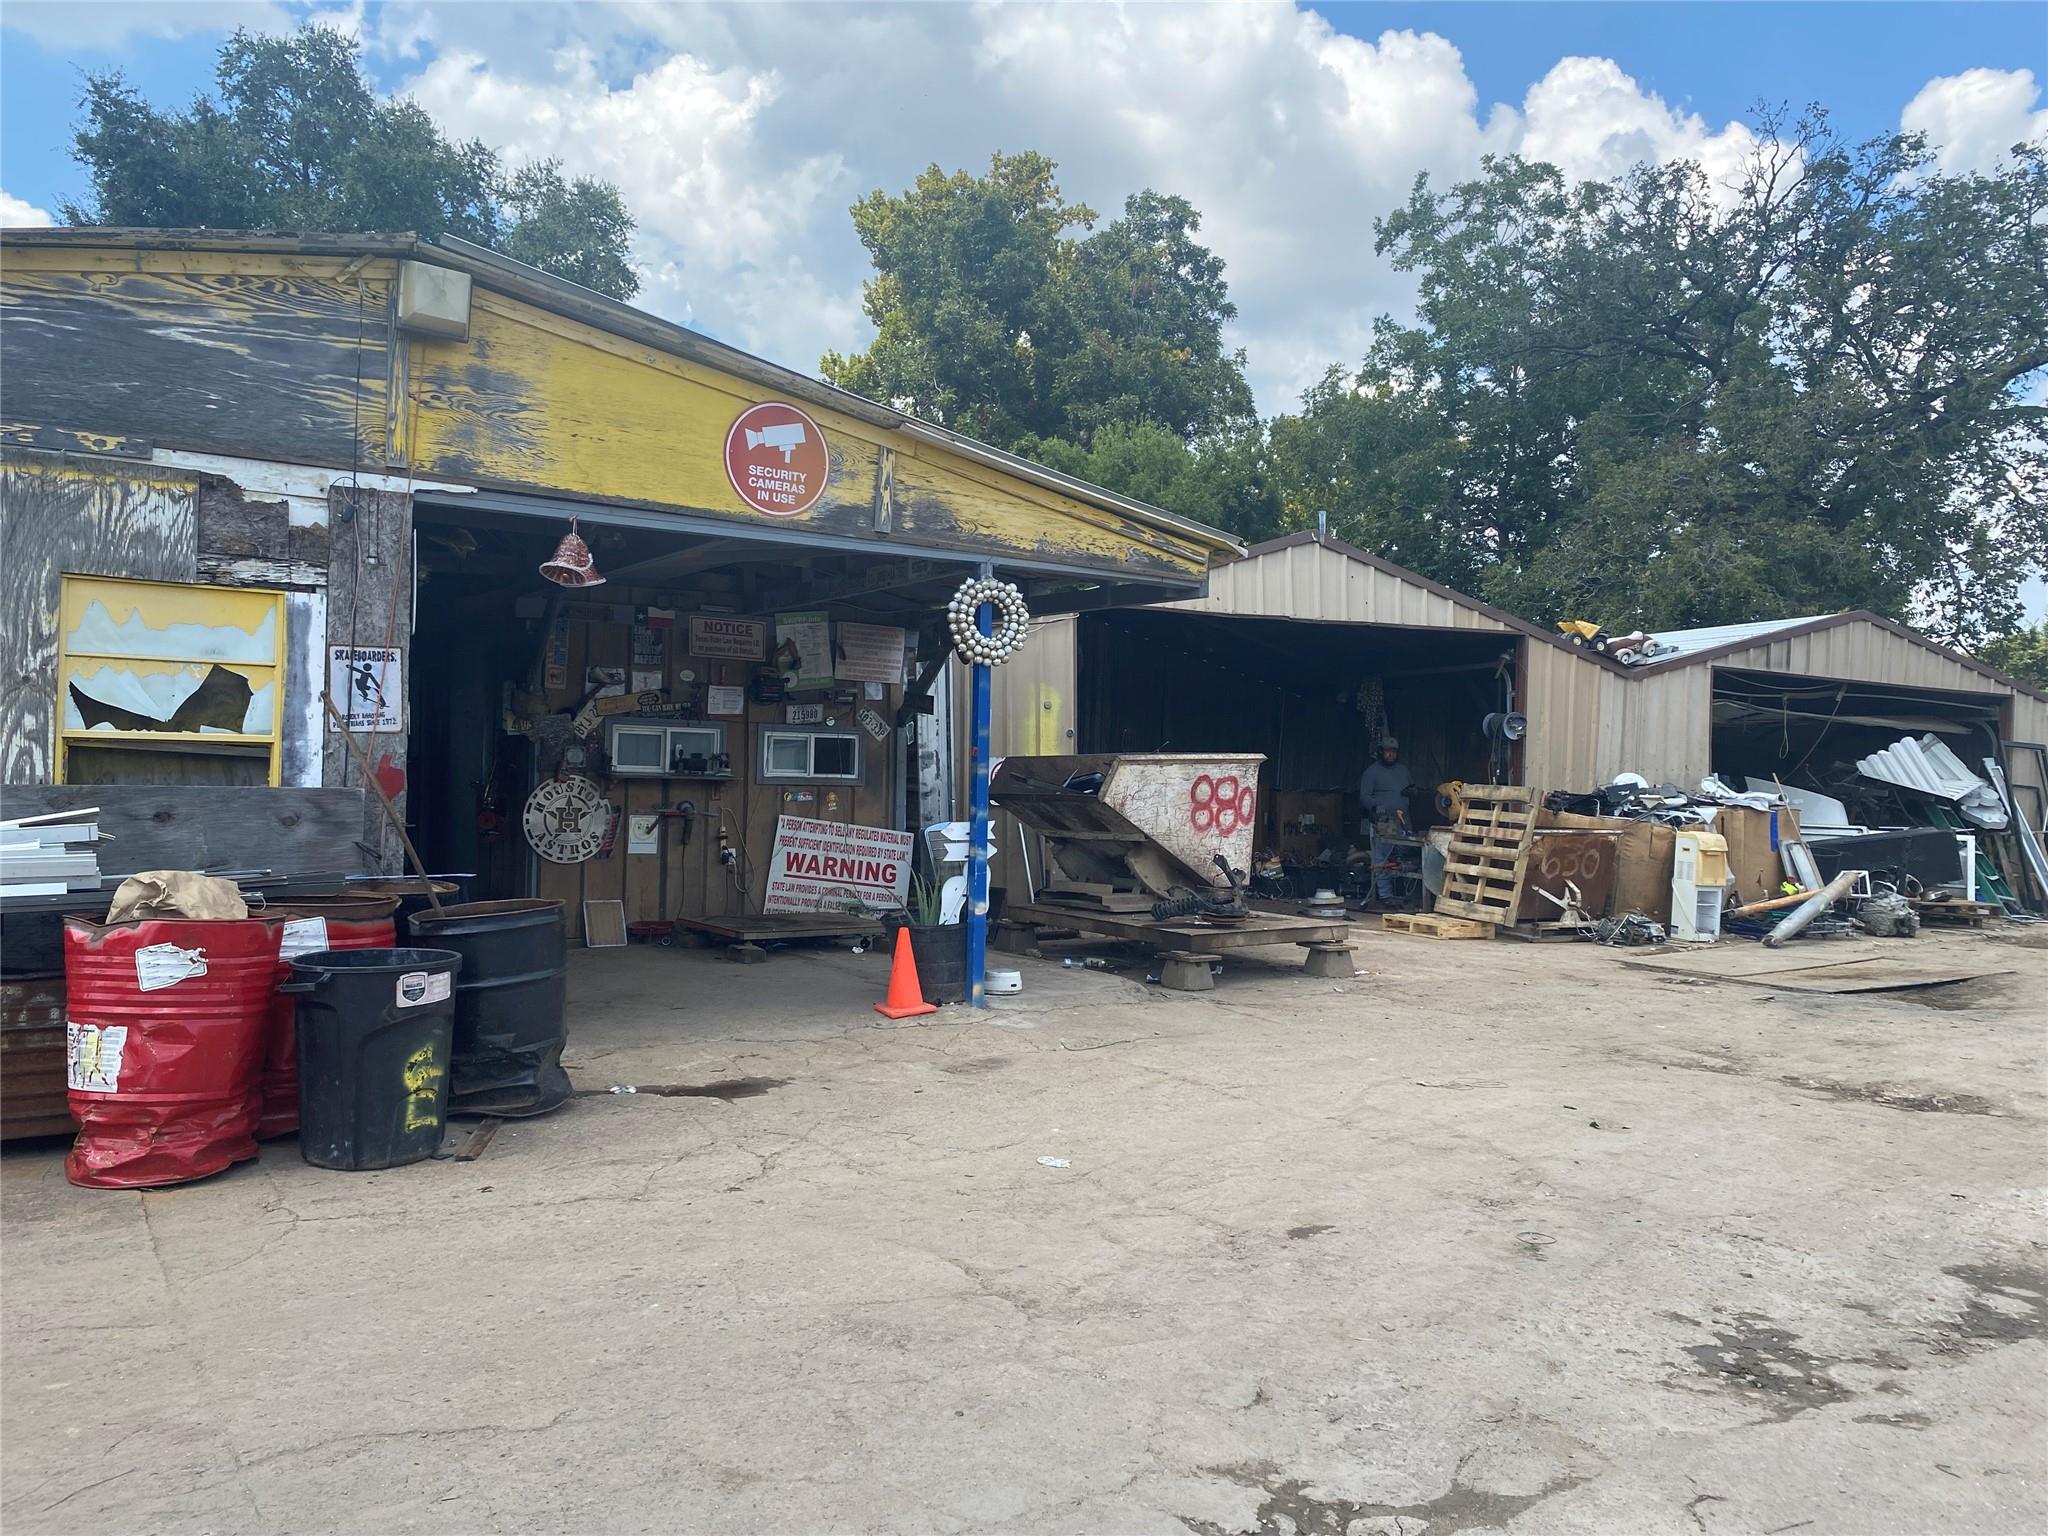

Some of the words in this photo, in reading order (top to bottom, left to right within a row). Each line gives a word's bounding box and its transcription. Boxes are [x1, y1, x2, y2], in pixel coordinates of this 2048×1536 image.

[748, 464, 807, 482] SECURITY
[748, 477, 806, 494] CAMERAS
[757, 490, 769, 501] IN
[773, 493, 796, 504] USE
[704, 620, 752, 635] NOTICE
[533, 782, 603, 813] HOUSTON
[1190, 774, 1255, 836] 880
[555, 807, 583, 832] H
[534, 832, 600, 854] ASTROS
[786, 818, 803, 832] PERSON
[802, 821, 828, 835] ATTEMPTING
[828, 823, 835, 836] TO
[855, 828, 880, 842] REGULATED
[880, 831, 900, 845] MATERIAL
[900, 834, 912, 846] MUST
[797, 836, 822, 850] SUFFICIENT
[822, 839, 855, 856] IDENTIFICATION
[855, 844, 878, 858] REQUIRED
[877, 847, 884, 859] BY
[884, 848, 896, 861] STATE
[785, 852, 897, 883] WARNING
[767, 895, 801, 906] INTENTIONALLY
[772, 881, 786, 891] STATE
[785, 882, 796, 892] LAW
[795, 884, 818, 895] PROVIDES
[863, 891, 872, 900] FOR
[876, 893, 892, 903] PERSON
